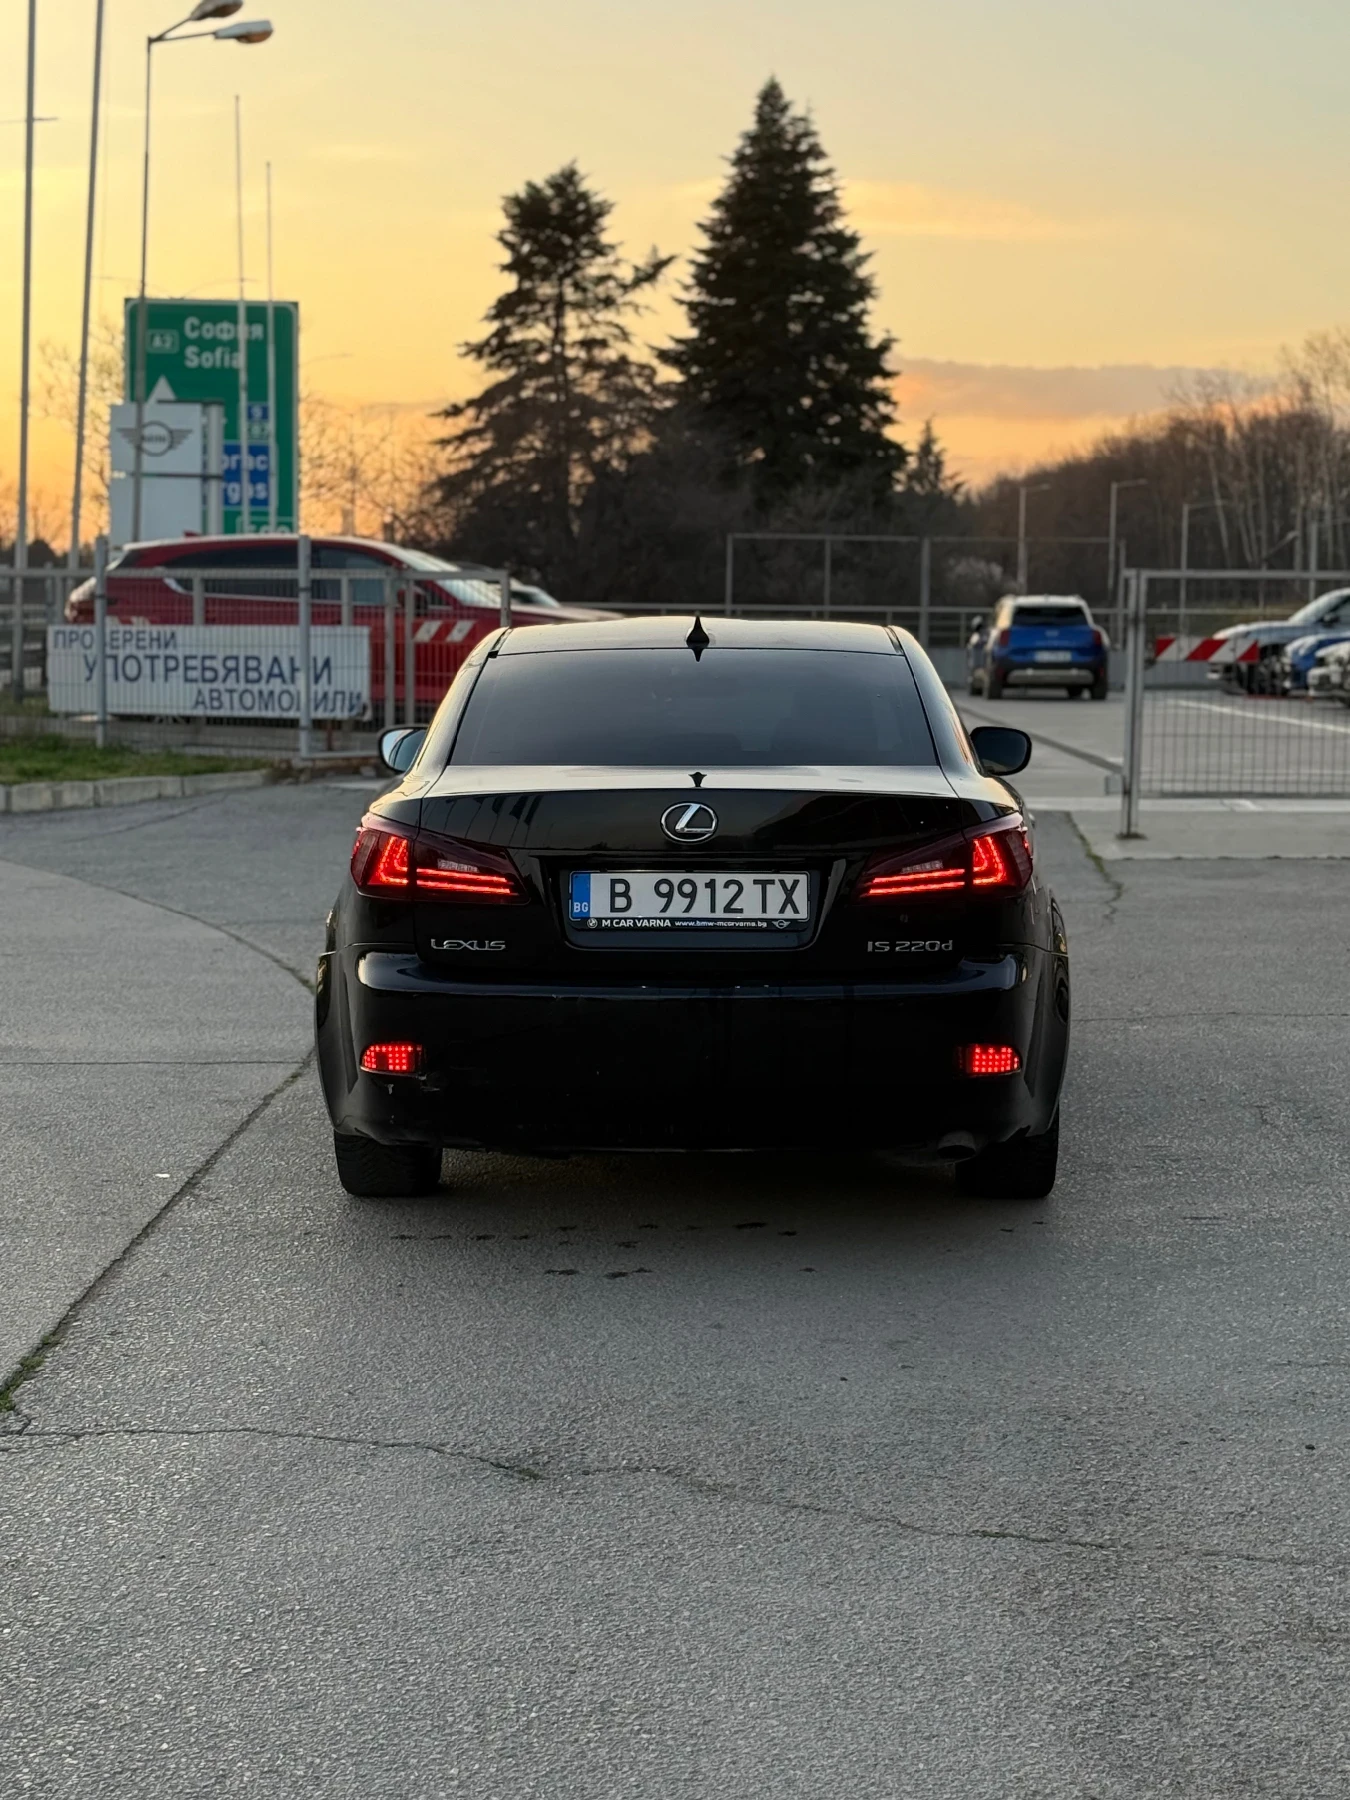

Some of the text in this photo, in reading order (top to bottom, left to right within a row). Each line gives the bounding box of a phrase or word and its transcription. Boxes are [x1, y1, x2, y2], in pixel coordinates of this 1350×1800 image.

[54, 629, 177, 650] ПРОЕРЕНИ
[192, 688, 361, 713] АВТОМОИЛИ
[609, 878, 632, 914] B
[573, 902, 589, 913] BG
[601, 919, 611, 928] M
[613, 919, 634, 928] CAR
[636, 919, 671, 928] VARNA
[430, 938, 506, 951] LEXUS
[867, 939, 953, 952] IS 220d
